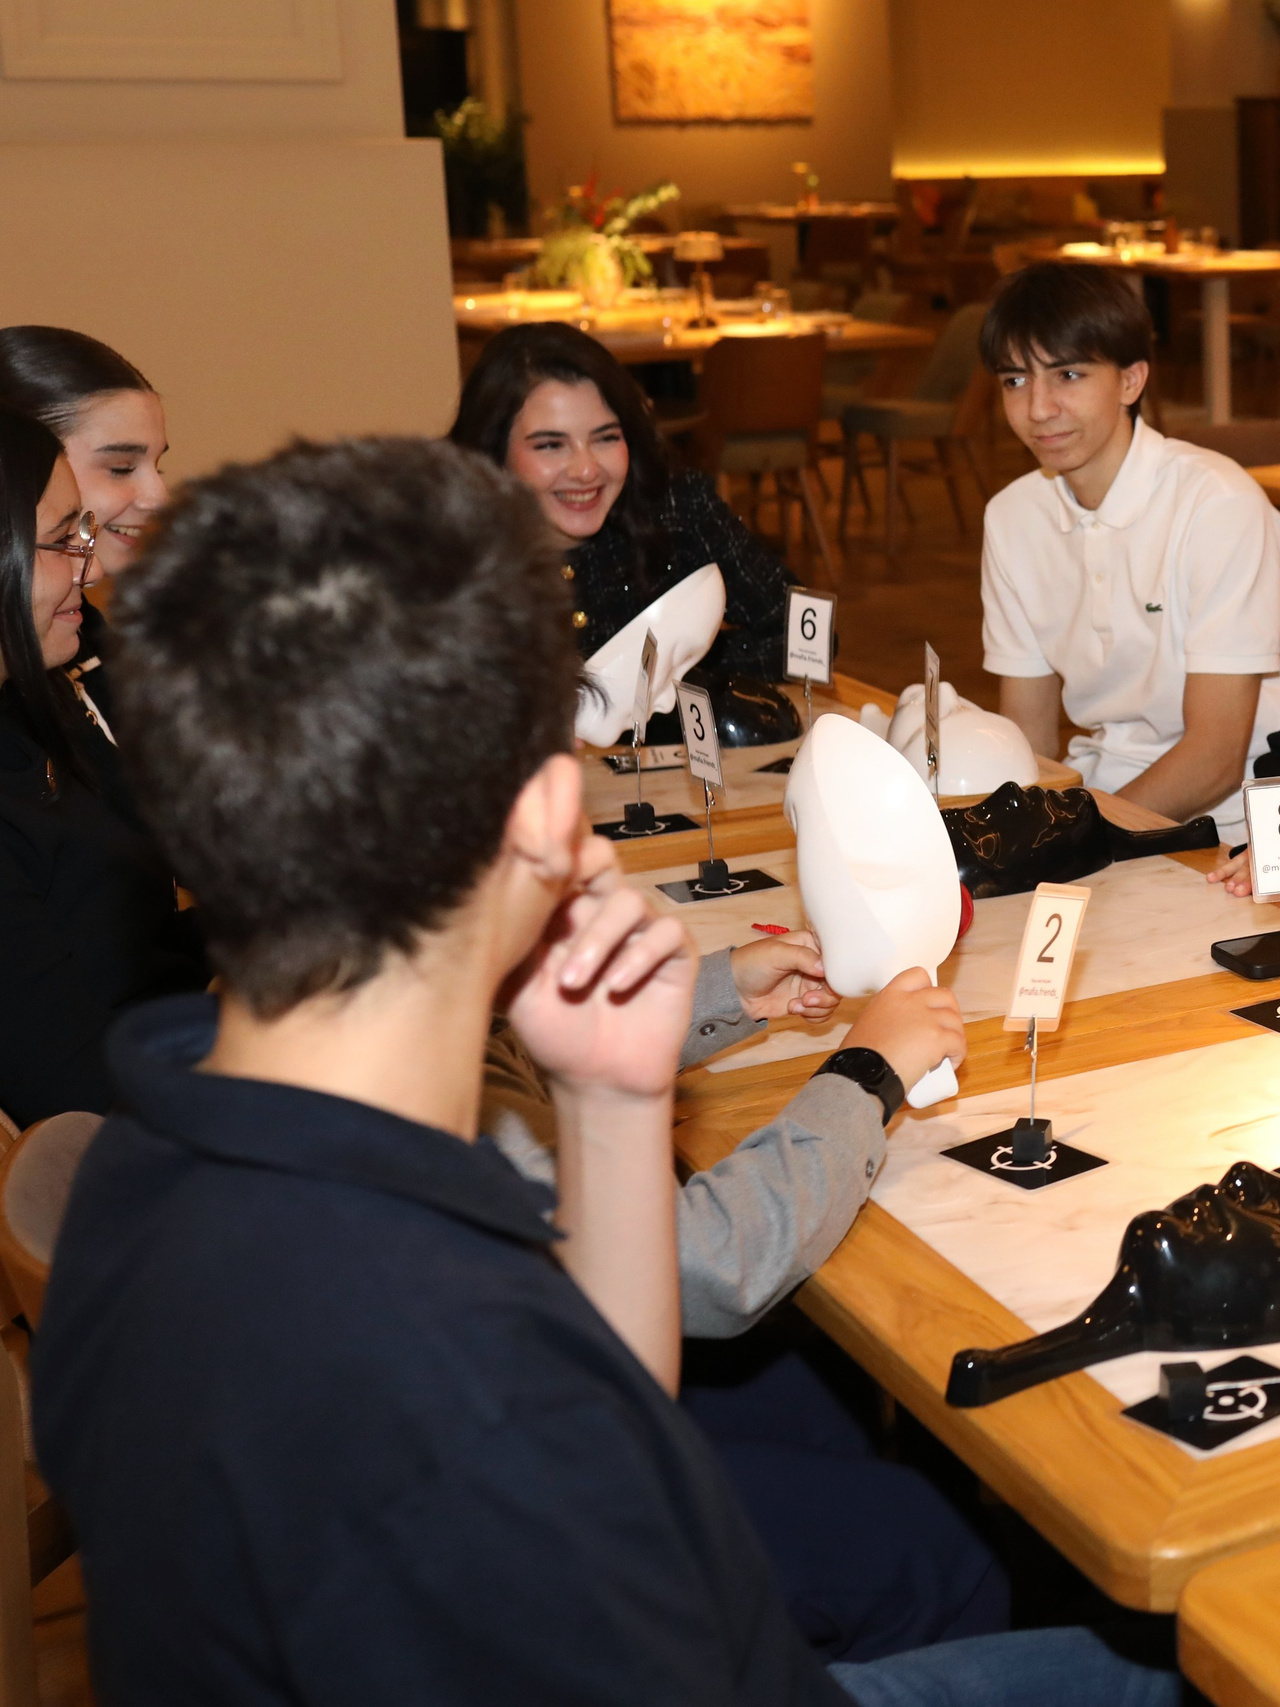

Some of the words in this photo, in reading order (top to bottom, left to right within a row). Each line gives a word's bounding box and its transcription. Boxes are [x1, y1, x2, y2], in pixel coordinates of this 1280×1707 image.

[801, 607, 817, 641] 6
[690, 703, 705, 741] 3
[1036, 913, 1063, 963] 2
